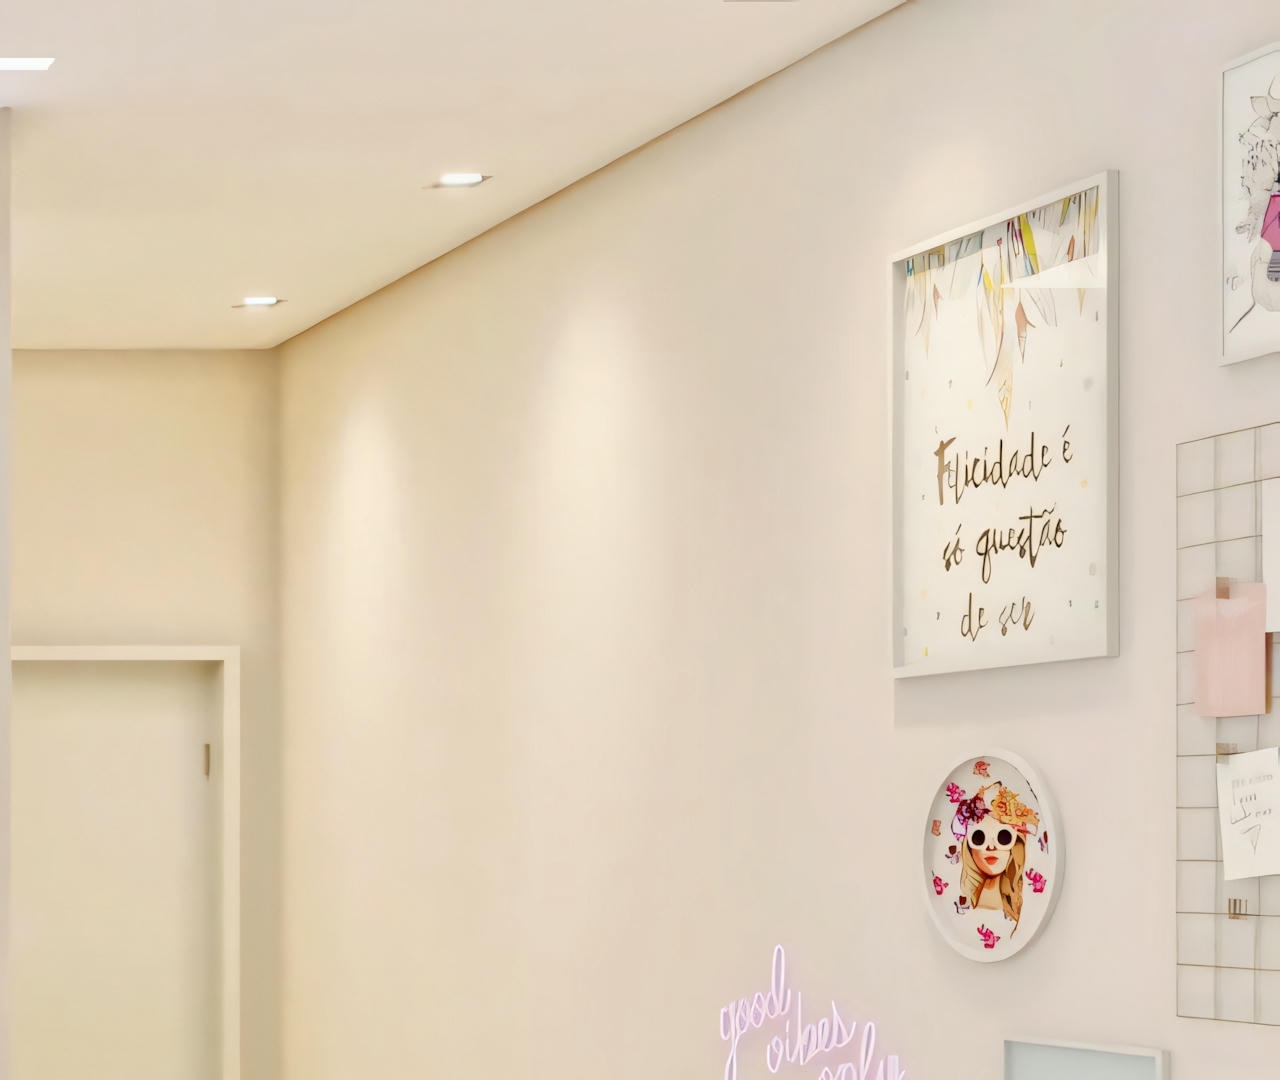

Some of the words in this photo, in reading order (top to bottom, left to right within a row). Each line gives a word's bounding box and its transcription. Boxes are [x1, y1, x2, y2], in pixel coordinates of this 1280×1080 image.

[934, 431, 1052, 505] Felicidade
[1062, 424, 1073, 463] é
[943, 523, 965, 572] só
[975, 502, 1067, 584] questão
[960, 592, 988, 641] de
[998, 596, 1035, 636] ser
[766, 991, 856, 1073] vibes
